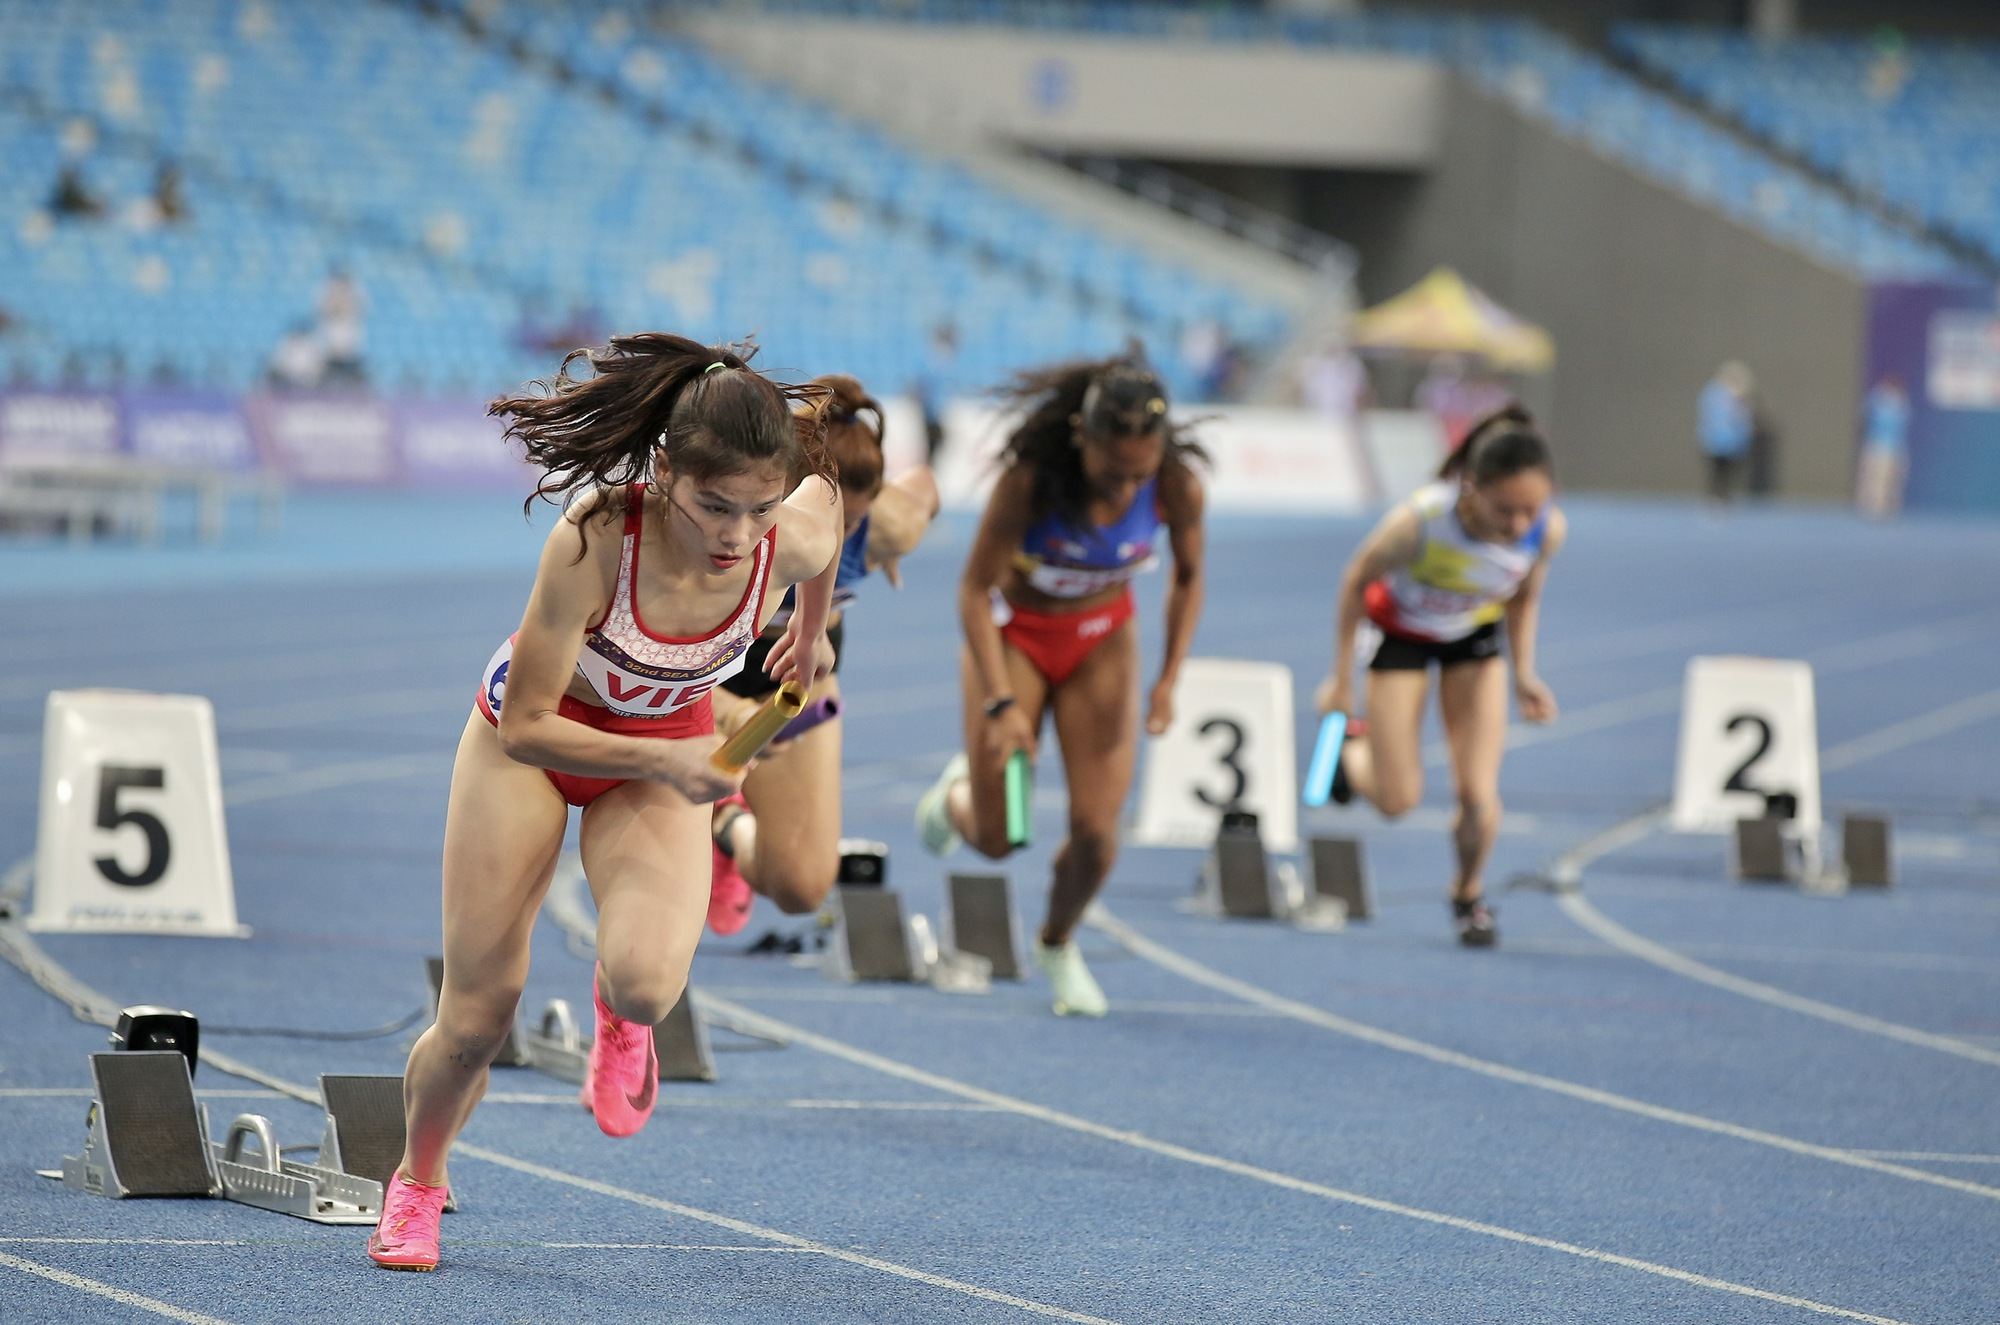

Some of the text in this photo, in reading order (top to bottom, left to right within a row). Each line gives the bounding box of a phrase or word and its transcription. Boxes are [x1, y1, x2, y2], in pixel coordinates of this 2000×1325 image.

[607, 671, 719, 708] VIE
[624, 648, 735, 679] 32nd SEA GAMES
[1193, 716, 1247, 811] 3
[1723, 714, 1774, 795] 2
[93, 765, 172, 888] 5
